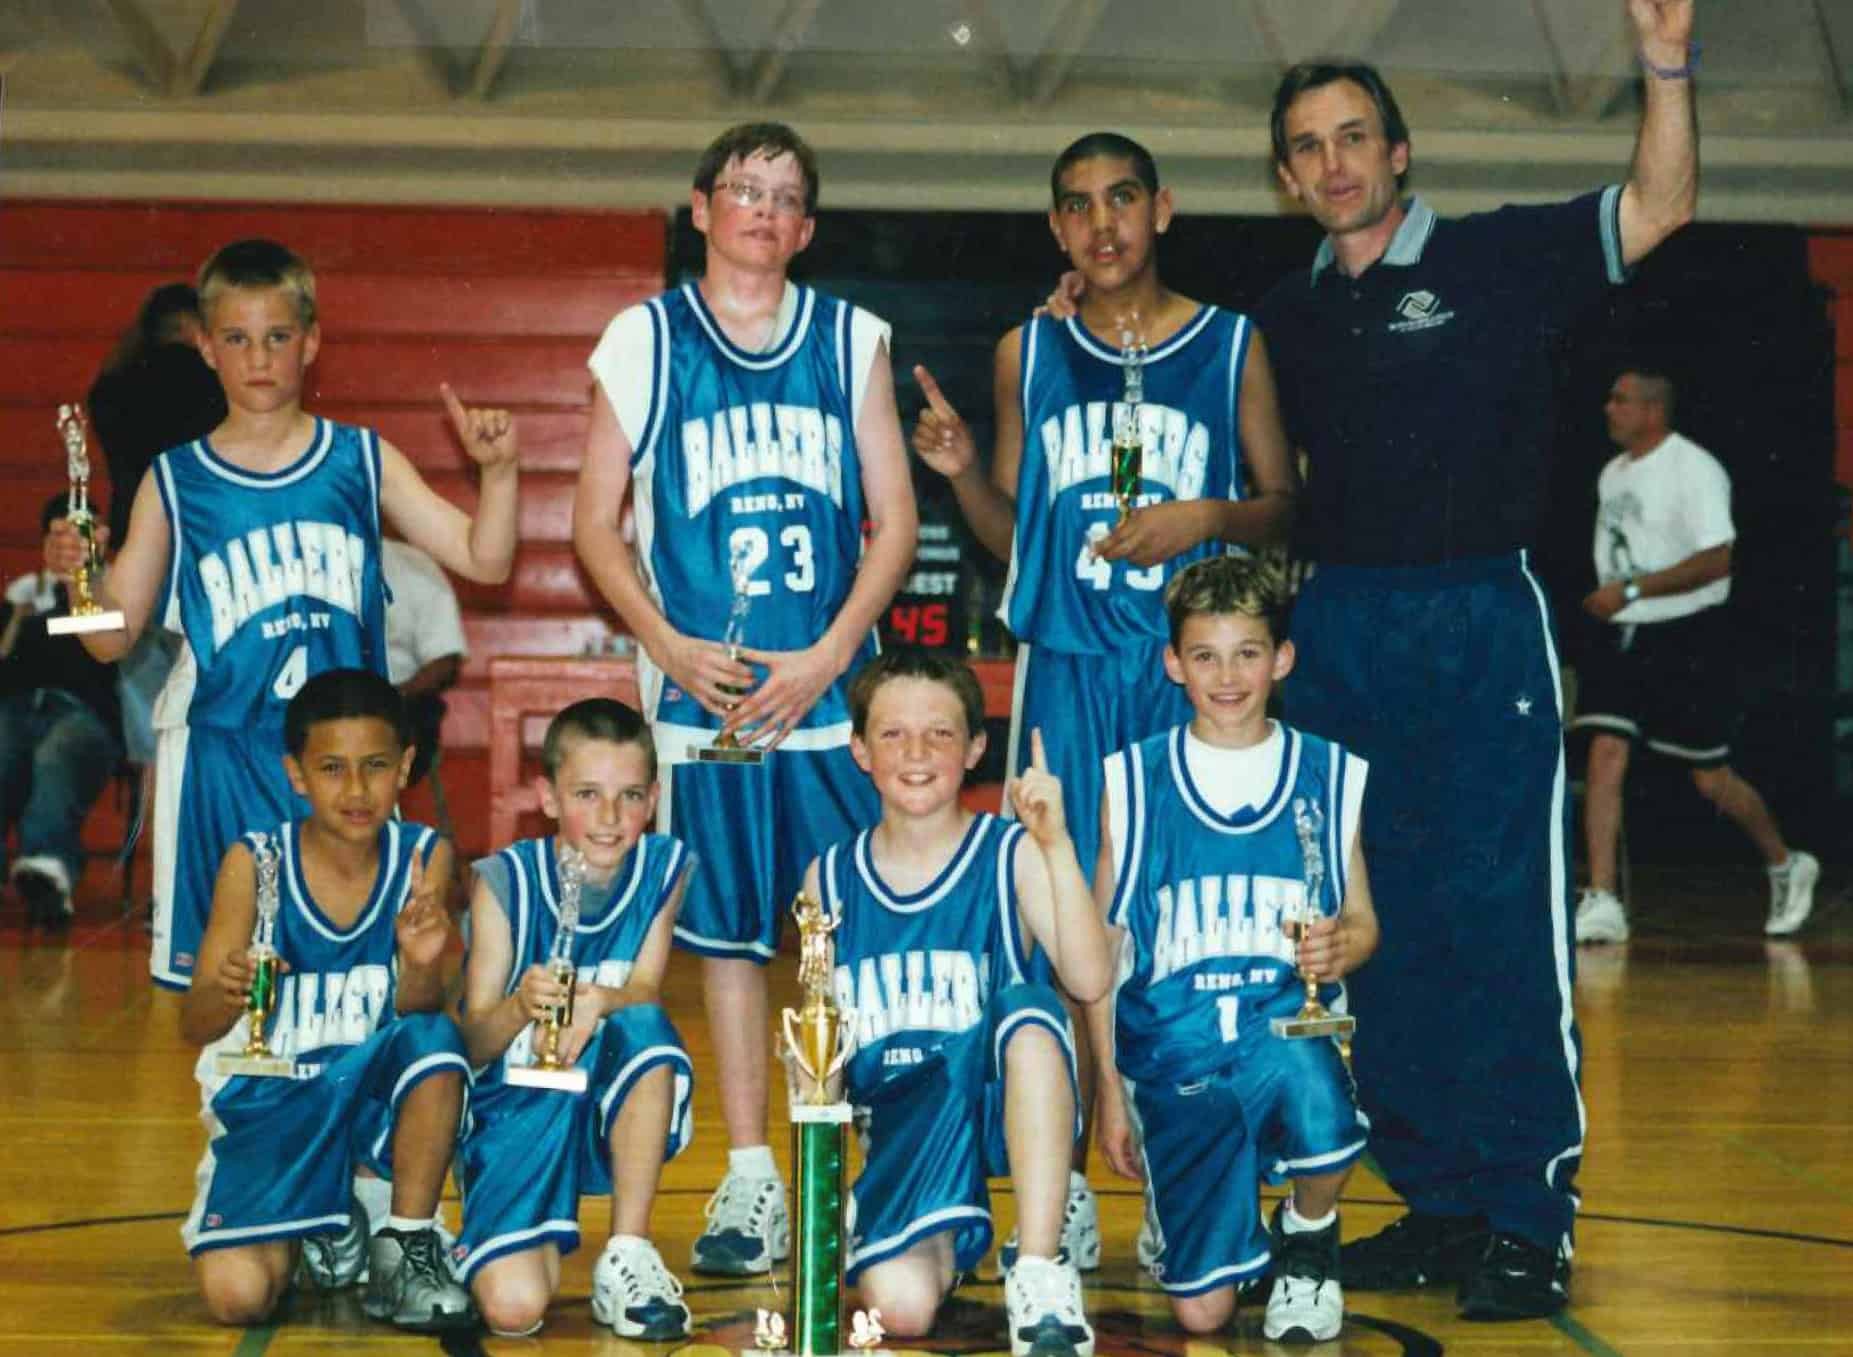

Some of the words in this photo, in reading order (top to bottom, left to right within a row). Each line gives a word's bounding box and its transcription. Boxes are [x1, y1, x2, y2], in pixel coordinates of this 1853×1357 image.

[683, 401, 843, 519] BALLERS
[730, 525, 816, 596] 23
[1216, 995, 1239, 1043] 1
